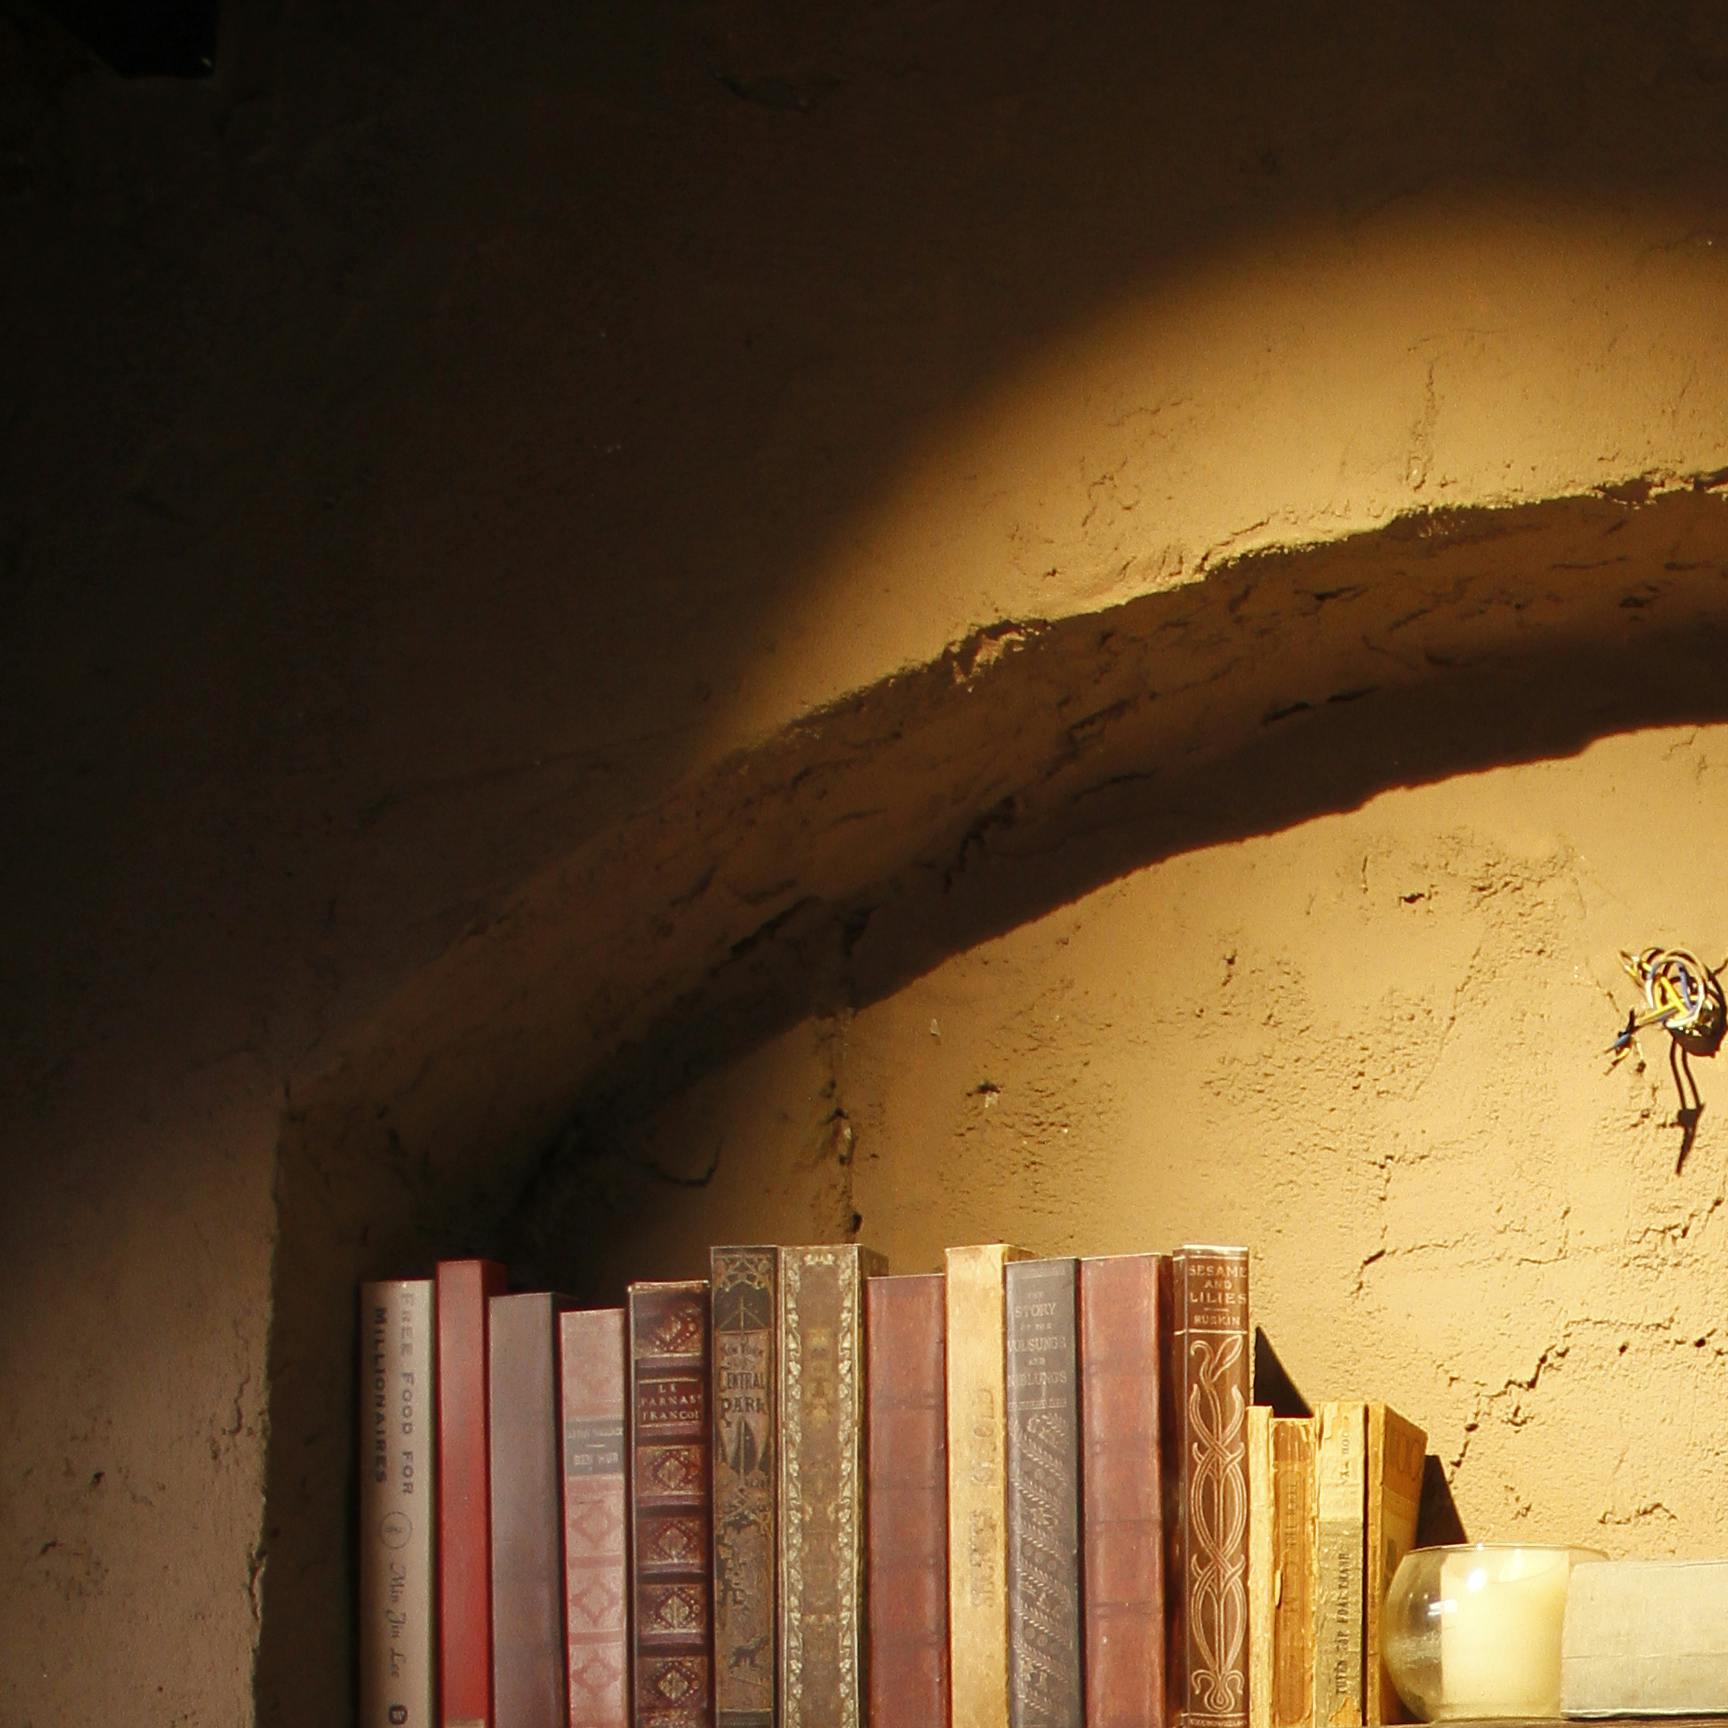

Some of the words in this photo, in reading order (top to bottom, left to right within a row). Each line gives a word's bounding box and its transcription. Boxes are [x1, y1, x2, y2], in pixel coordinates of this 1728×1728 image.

[1188, 1264, 1247, 1278] SESAME
[1204, 1279, 1232, 1290] AND
[1190, 1291, 1247, 1305] LILIES
[1015, 1303, 1056, 1318] STORY
[1194, 1314, 1241, 1327] RUSKIN
[374, 1307, 387, 1484] MILLIONAIRES
[400, 1372, 414, 1435] FOOD
[401, 1451, 414, 1495] FOR
